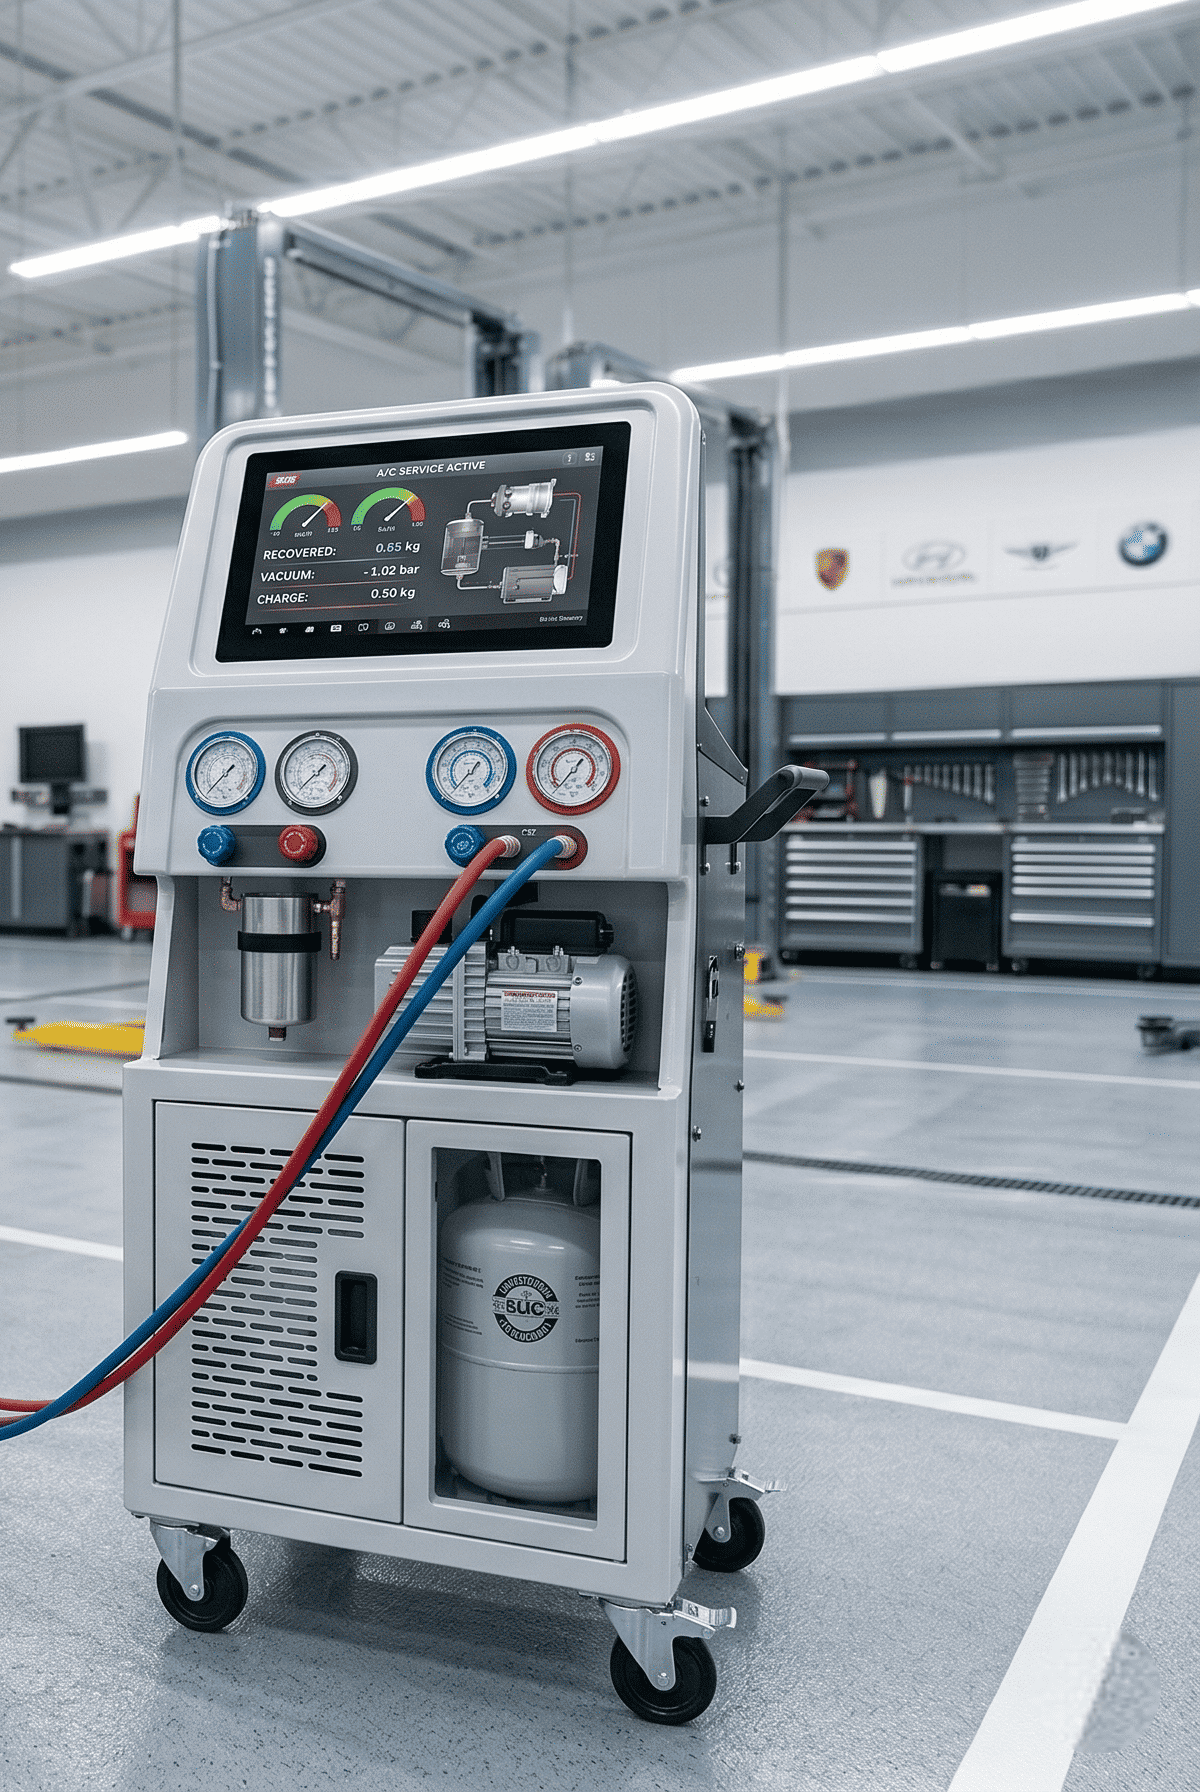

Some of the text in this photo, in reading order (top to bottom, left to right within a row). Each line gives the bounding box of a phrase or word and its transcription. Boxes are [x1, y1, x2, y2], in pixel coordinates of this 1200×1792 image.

[376, 460, 486, 478] A/C SERVICE ACTIVE
[263, 541, 421, 560] RECOVERED: 0.65 kg
[260, 570, 315, 582] VACUUM:
[400, 564, 420, 575] bar
[257, 587, 416, 605] CHARGE: 0.50 kg
